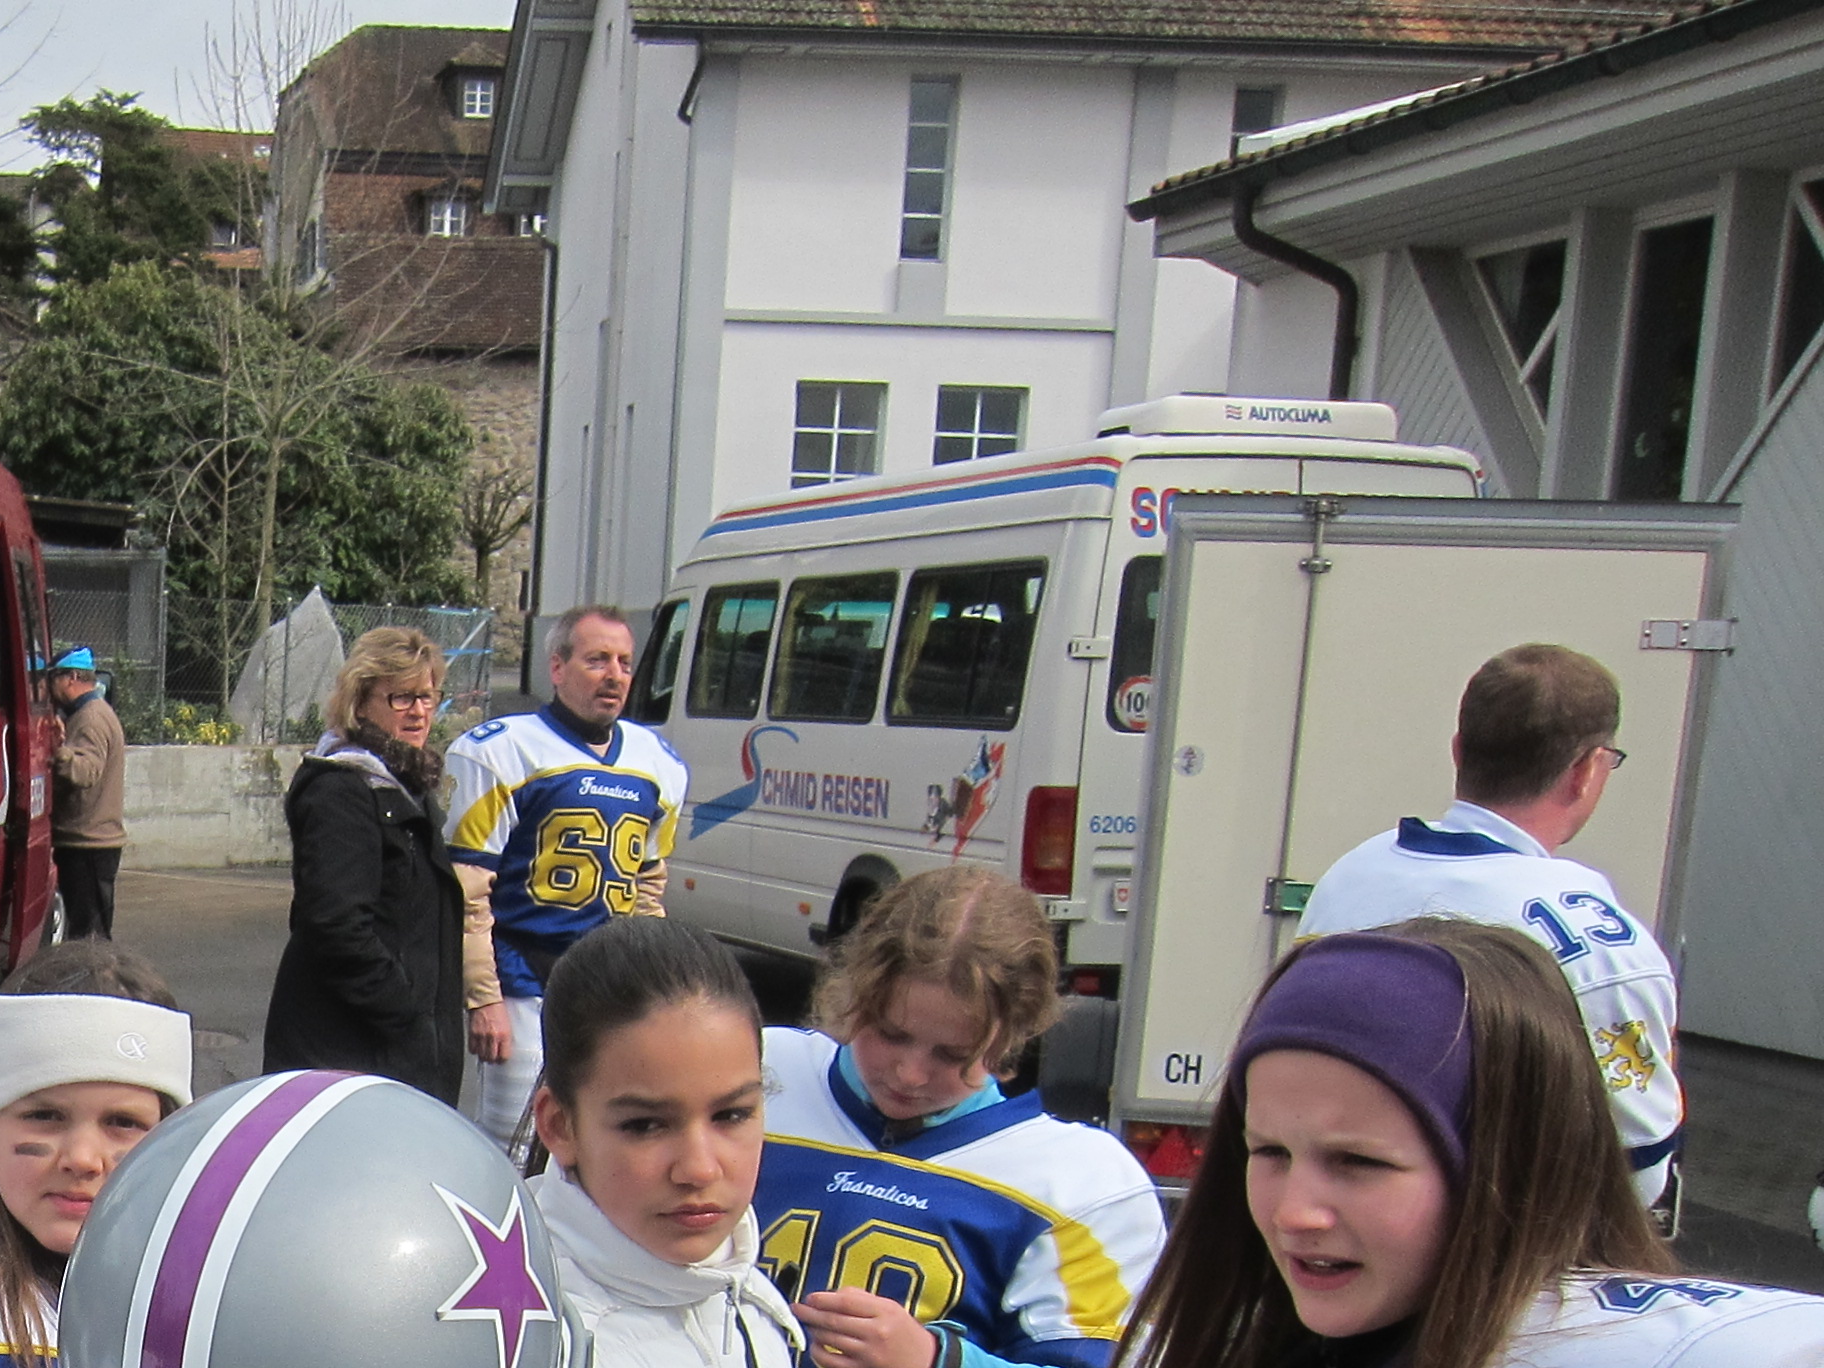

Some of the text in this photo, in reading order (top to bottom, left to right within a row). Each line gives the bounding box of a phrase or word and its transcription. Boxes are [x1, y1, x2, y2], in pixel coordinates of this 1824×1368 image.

[1248, 406, 1332, 423] AUTOCLIMA
[1127, 692, 1150, 713] 10
[821, 773, 890, 819] REISEN
[1089, 815, 1137, 834] 6206
[526, 807, 652, 918] 69
[1522, 890, 1638, 965] 13
[1164, 1053, 1202, 1086] CH
[826, 1169, 929, 1212] Fasnaticos
